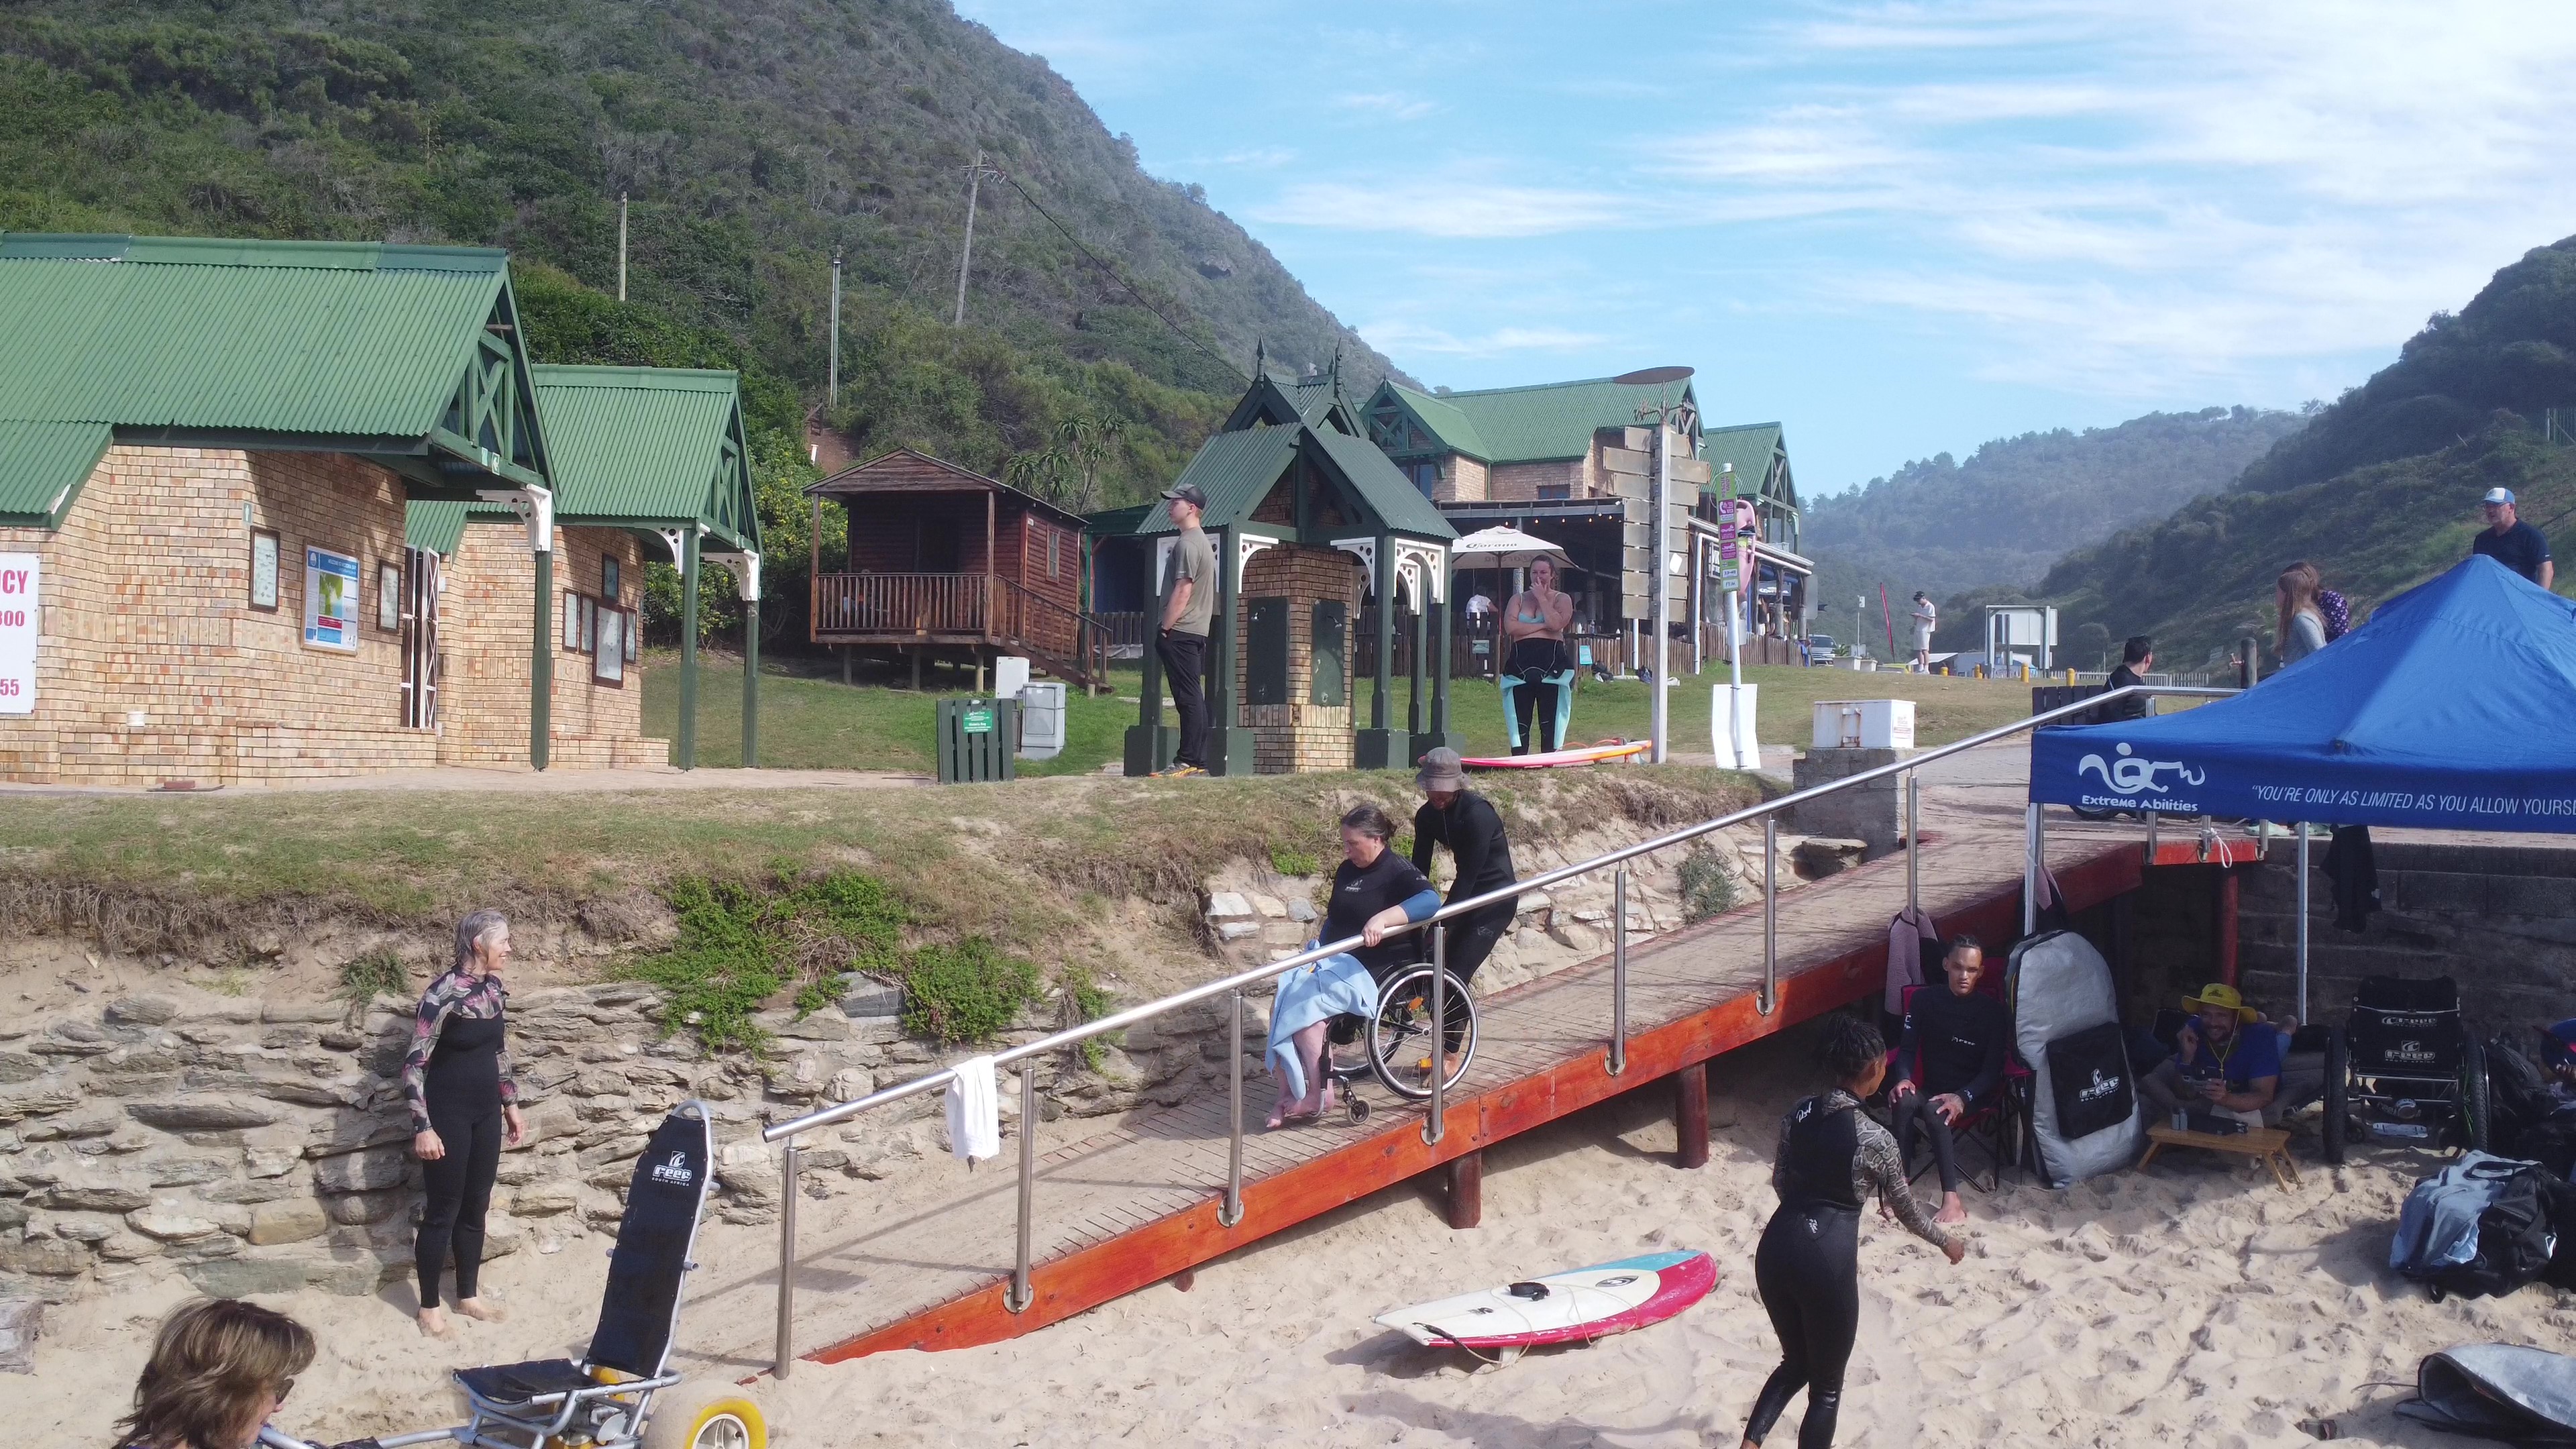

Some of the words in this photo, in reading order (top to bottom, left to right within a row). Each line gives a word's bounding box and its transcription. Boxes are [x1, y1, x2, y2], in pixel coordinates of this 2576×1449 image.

[0, 570, 29, 594] CY
[0, 678, 19, 696] 55
[2139, 798, 2198, 812] Abilities
[2305, 788, 2340, 804] ONLY
[2339, 791, 2359, 805] AS
[2360, 792, 2414, 808] LIMITED
[2415, 794, 2435, 810] AS
[2439, 795, 2468, 812] YOU
[2469, 797, 2520, 814] ALLOW
